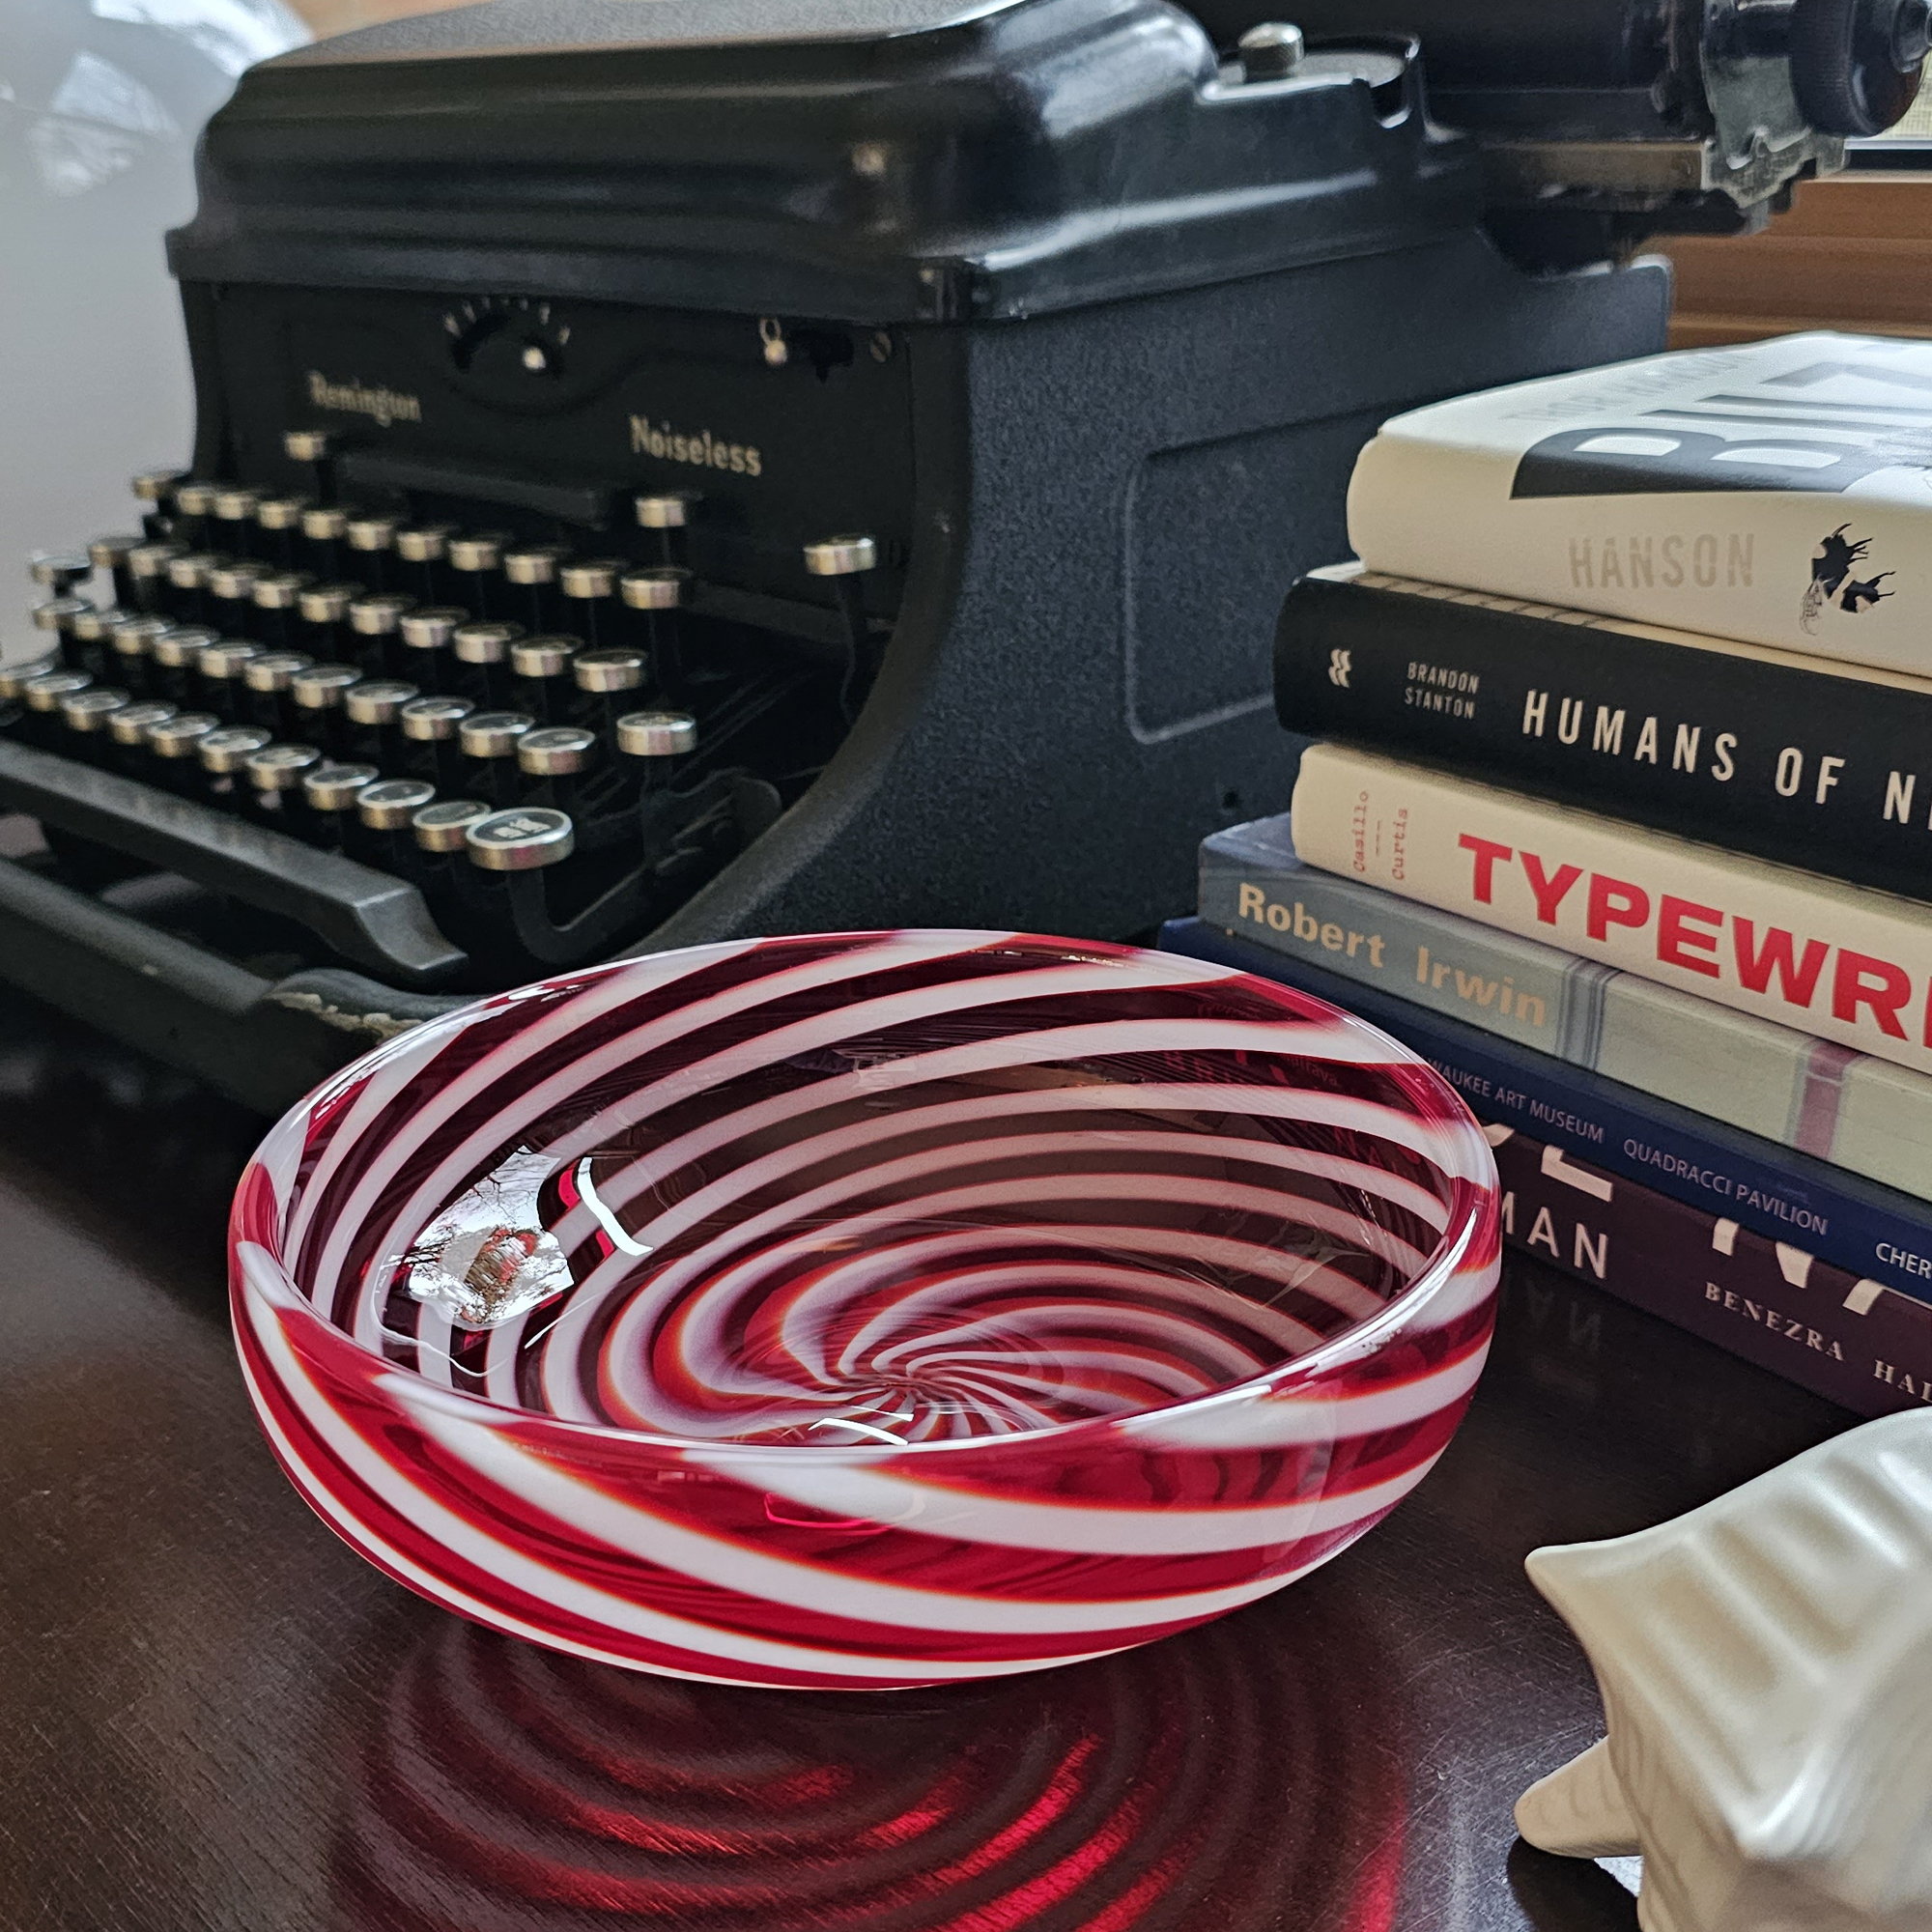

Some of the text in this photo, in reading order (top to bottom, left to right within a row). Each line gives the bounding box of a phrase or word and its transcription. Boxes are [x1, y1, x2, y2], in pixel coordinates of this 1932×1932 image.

[308, 369, 422, 428] Remington
[629, 413, 761, 476] Noiseless
[1568, 532, 1754, 588] HANSON
[1404, 686, 1475, 720] STANTON
[1406, 661, 1480, 695] BRANDON
[1521, 690, 1932, 831] HUMANS OF N
[1352, 790, 1369, 873] Casillo
[1391, 807, 1408, 881] Curtis
[1238, 882, 1546, 1027] Robert Irwin
[1494, 1087, 1526, 1111] ART
[1529, 1099, 1605, 1145] MUSEUM
[1623, 1138, 1732, 1196] QUADRACCI
[1736, 1183, 1829, 1236] PAVILION
[1704, 1281, 1845, 1362] BENEZRA
